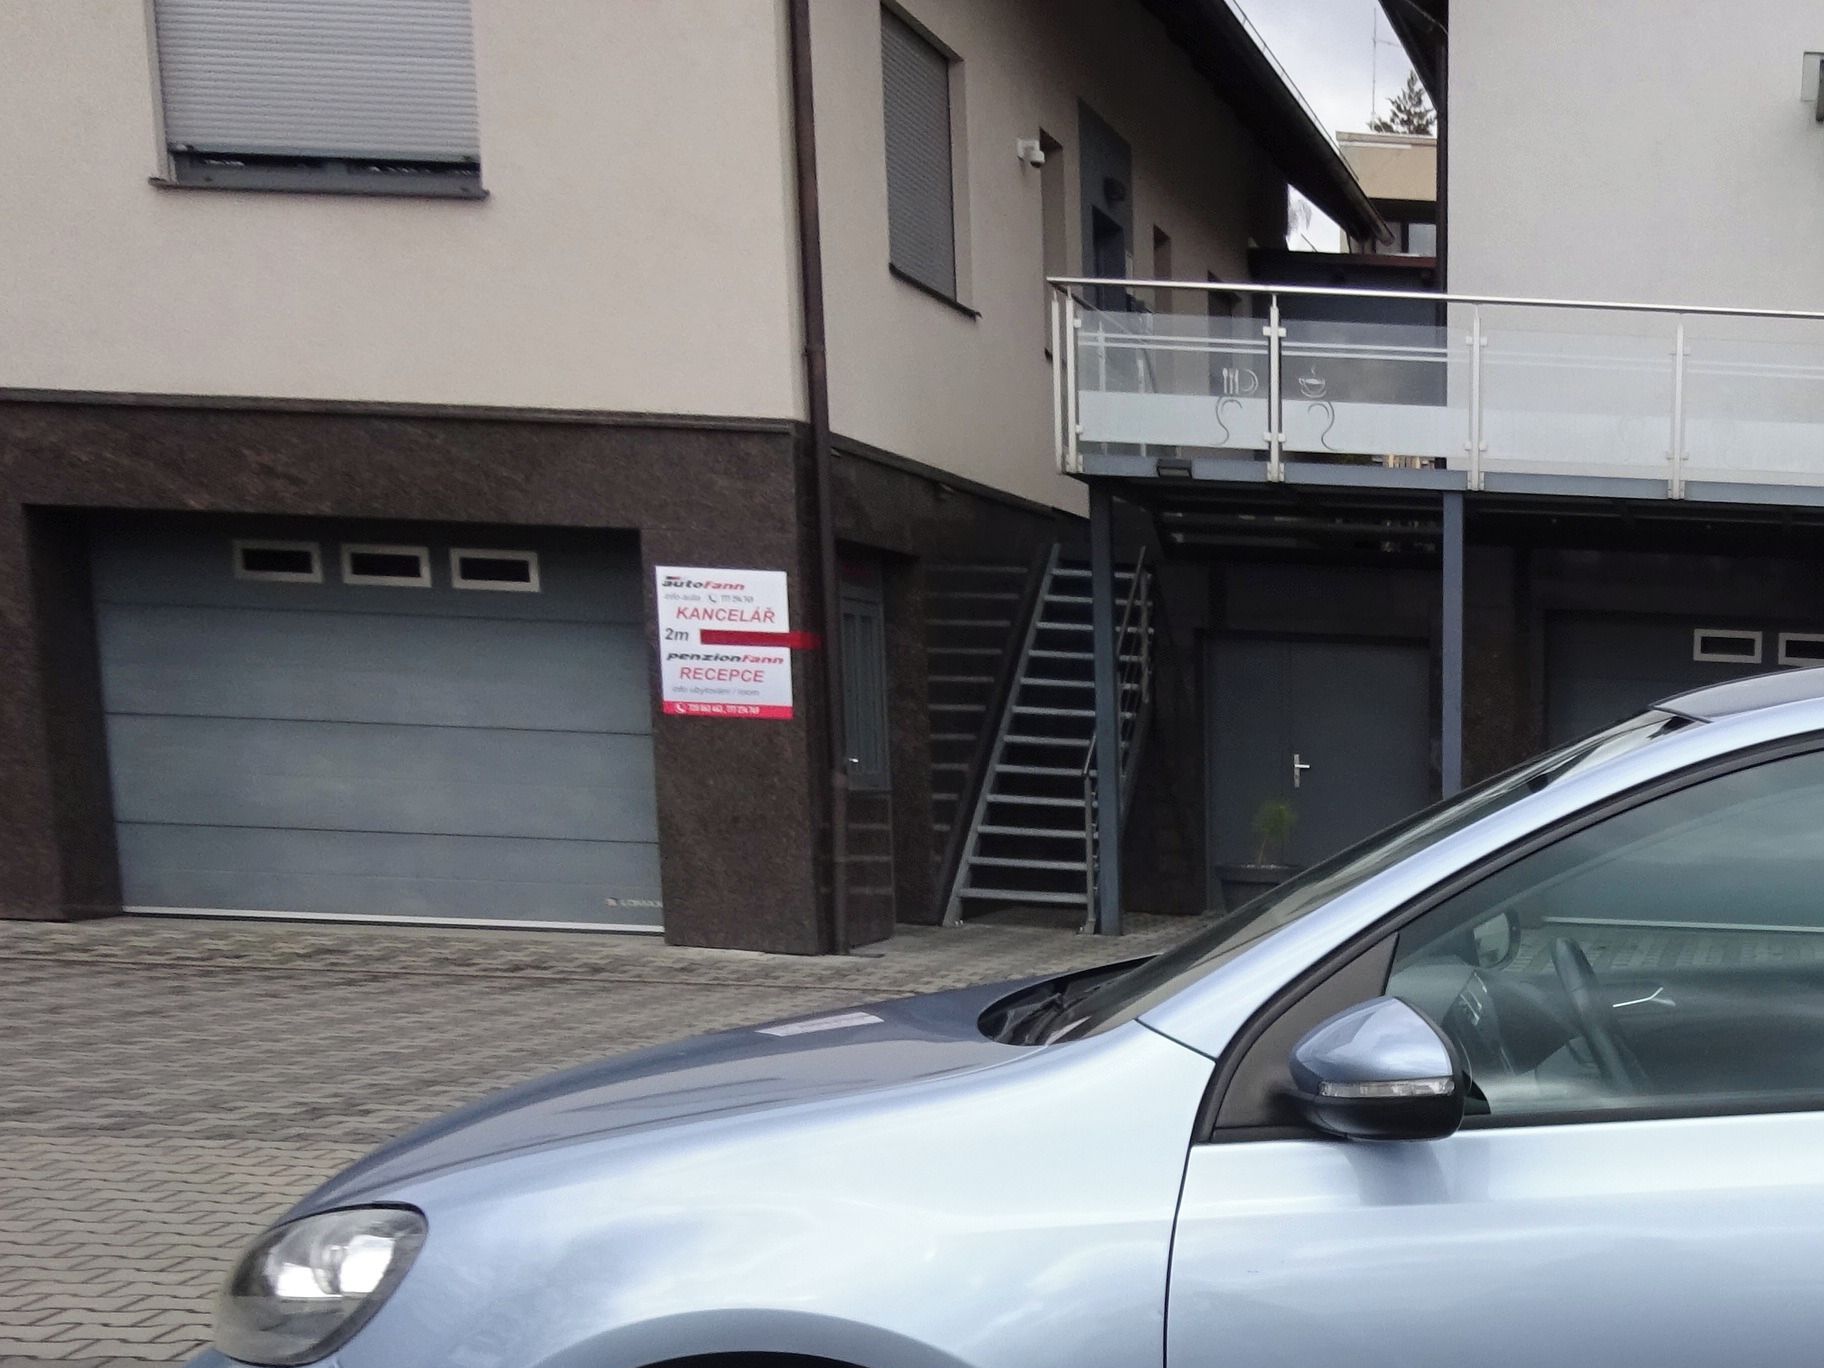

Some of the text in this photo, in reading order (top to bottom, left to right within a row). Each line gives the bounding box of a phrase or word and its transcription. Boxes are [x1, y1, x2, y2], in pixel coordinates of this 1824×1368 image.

[676, 606, 775, 623] KANCELÁŘ
[665, 627, 689, 641] 2m
[680, 667, 765, 683] RECEPCE
